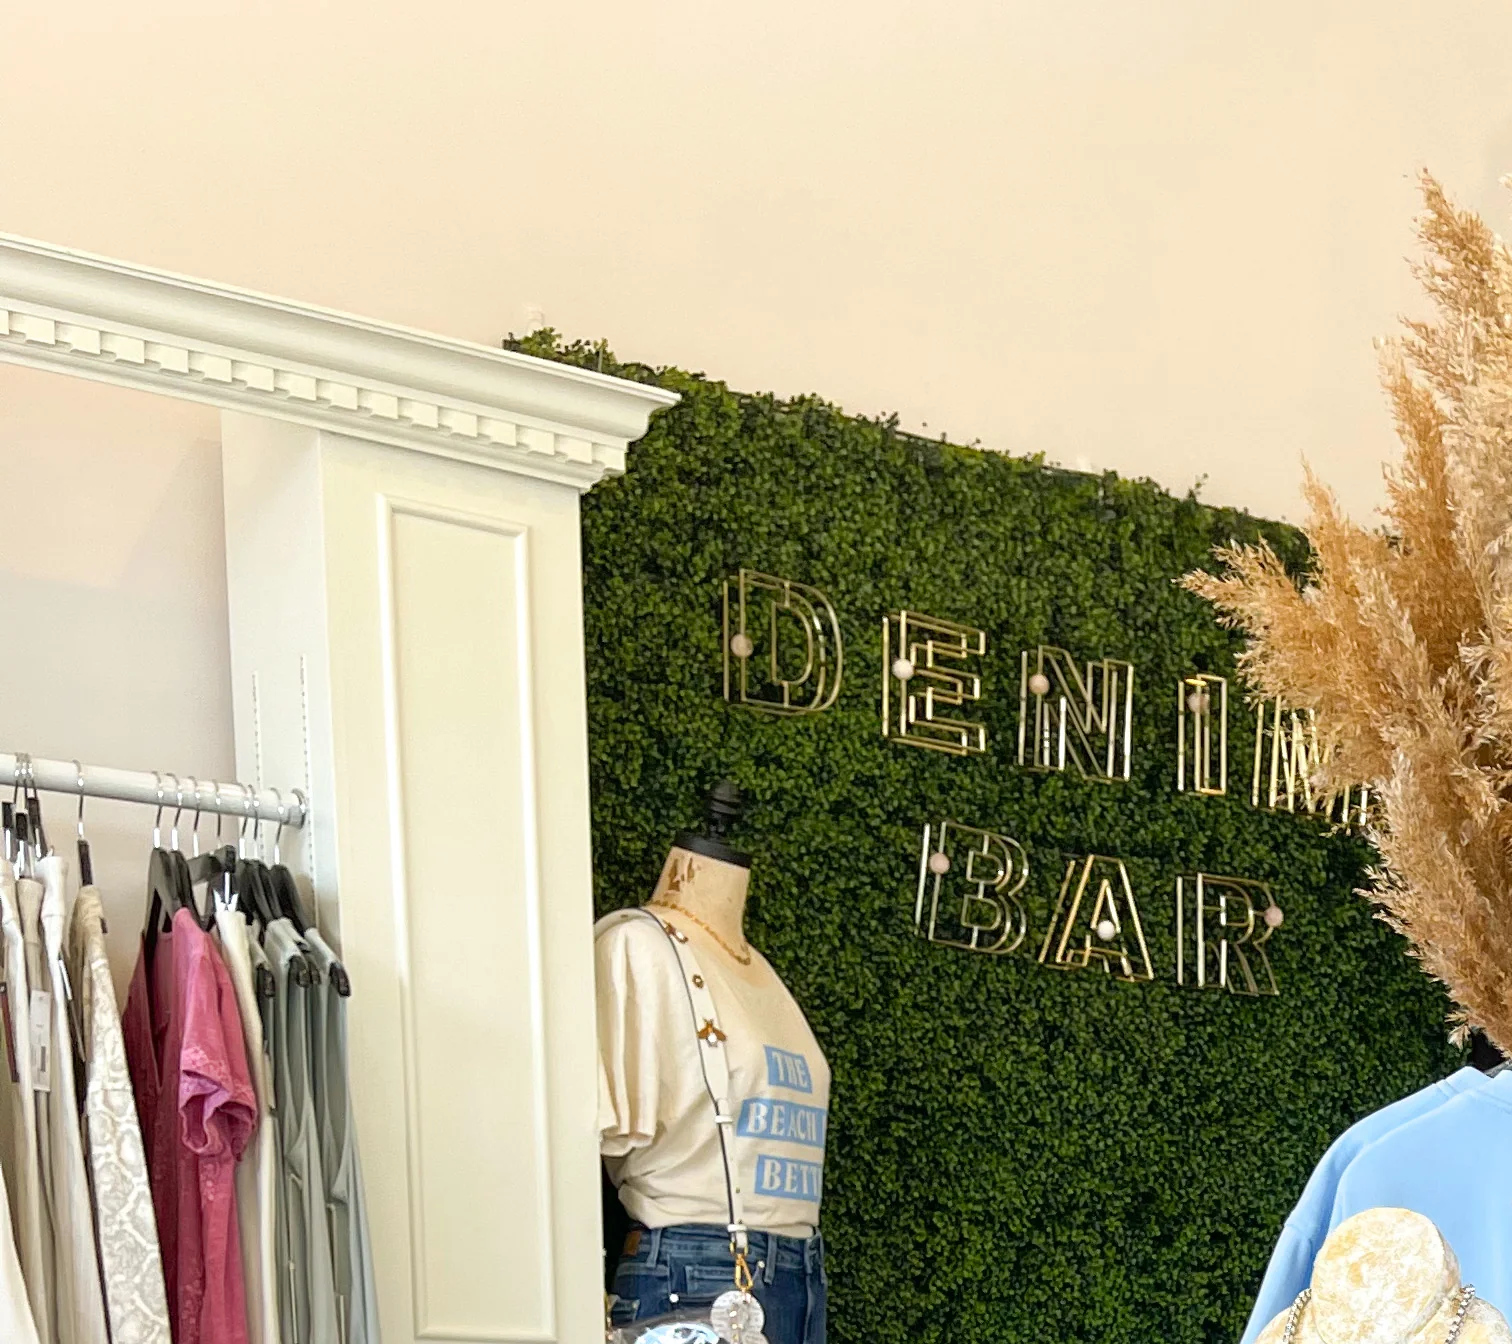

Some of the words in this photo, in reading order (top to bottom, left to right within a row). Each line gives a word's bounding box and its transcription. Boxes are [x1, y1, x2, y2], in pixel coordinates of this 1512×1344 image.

[914, 820, 1282, 995] BAR
[771, 1051, 808, 1088] THE
[746, 1101, 818, 1142] BEACH
[762, 1157, 822, 1198] BETT
